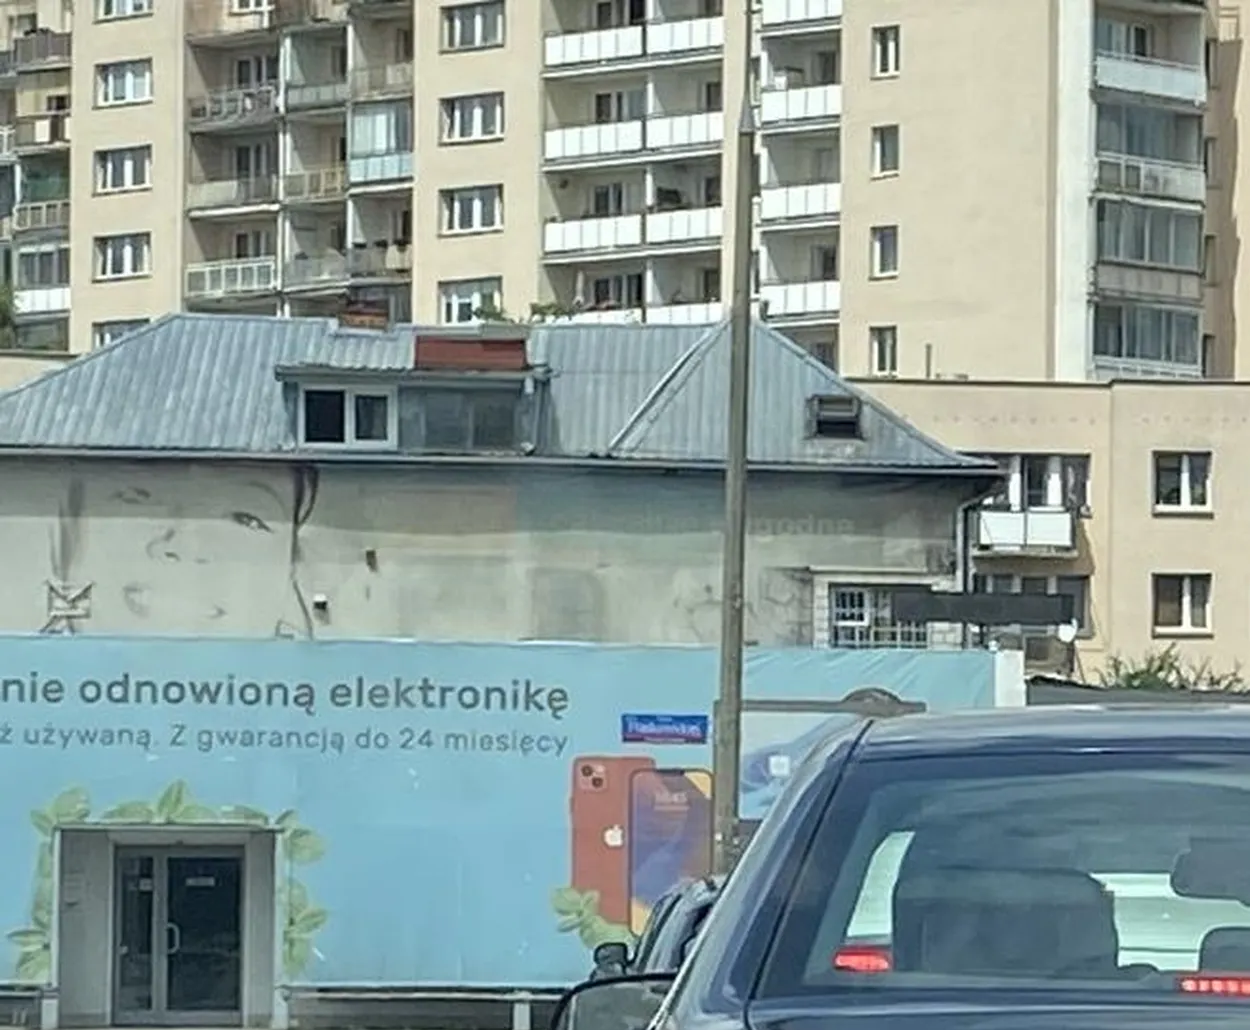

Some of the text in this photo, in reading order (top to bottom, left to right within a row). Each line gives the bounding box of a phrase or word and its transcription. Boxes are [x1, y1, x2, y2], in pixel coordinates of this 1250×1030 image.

[79, 673, 316, 716] odnowioną
[329, 676, 569, 719] elektronikę
[168, 724, 187, 746] Z
[197, 727, 345, 754] gwarancją
[354, 727, 389, 749] do
[399, 727, 433, 749] 24
[444, 729, 569, 757] miesięcy
